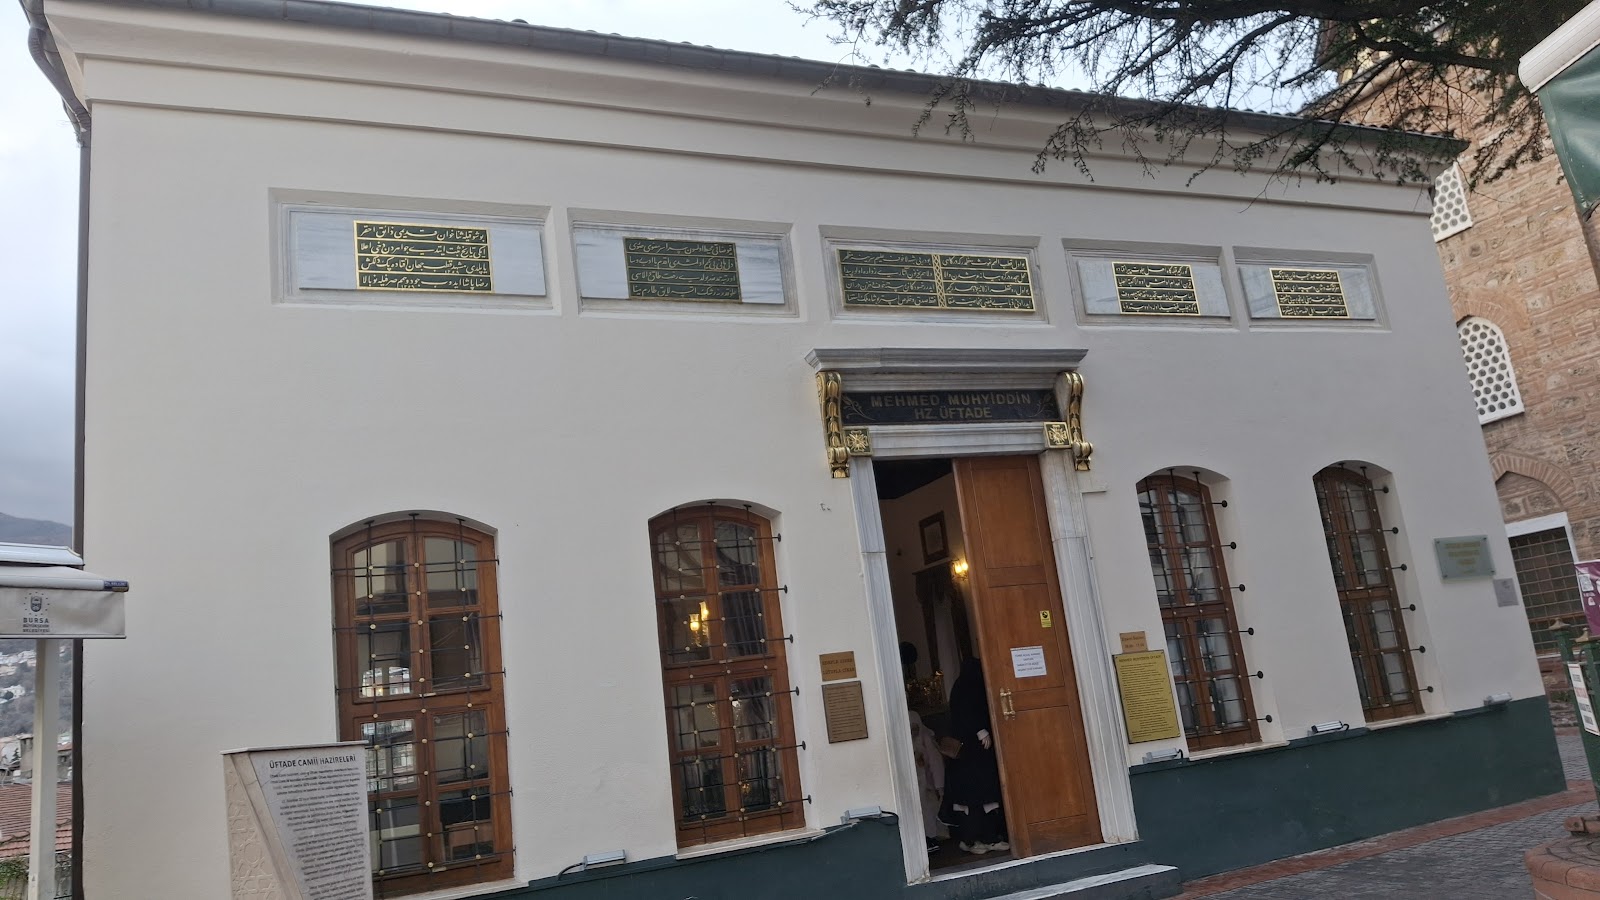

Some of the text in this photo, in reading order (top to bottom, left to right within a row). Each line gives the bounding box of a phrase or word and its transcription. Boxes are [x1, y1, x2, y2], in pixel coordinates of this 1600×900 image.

[871, 391, 1031, 408] MEHMED MUHYİDDİN
[940, 406, 993, 419] ÜFTADE
[270, 759, 297, 769] ÜFTADE
[297, 757, 319, 766] CAMİİ
